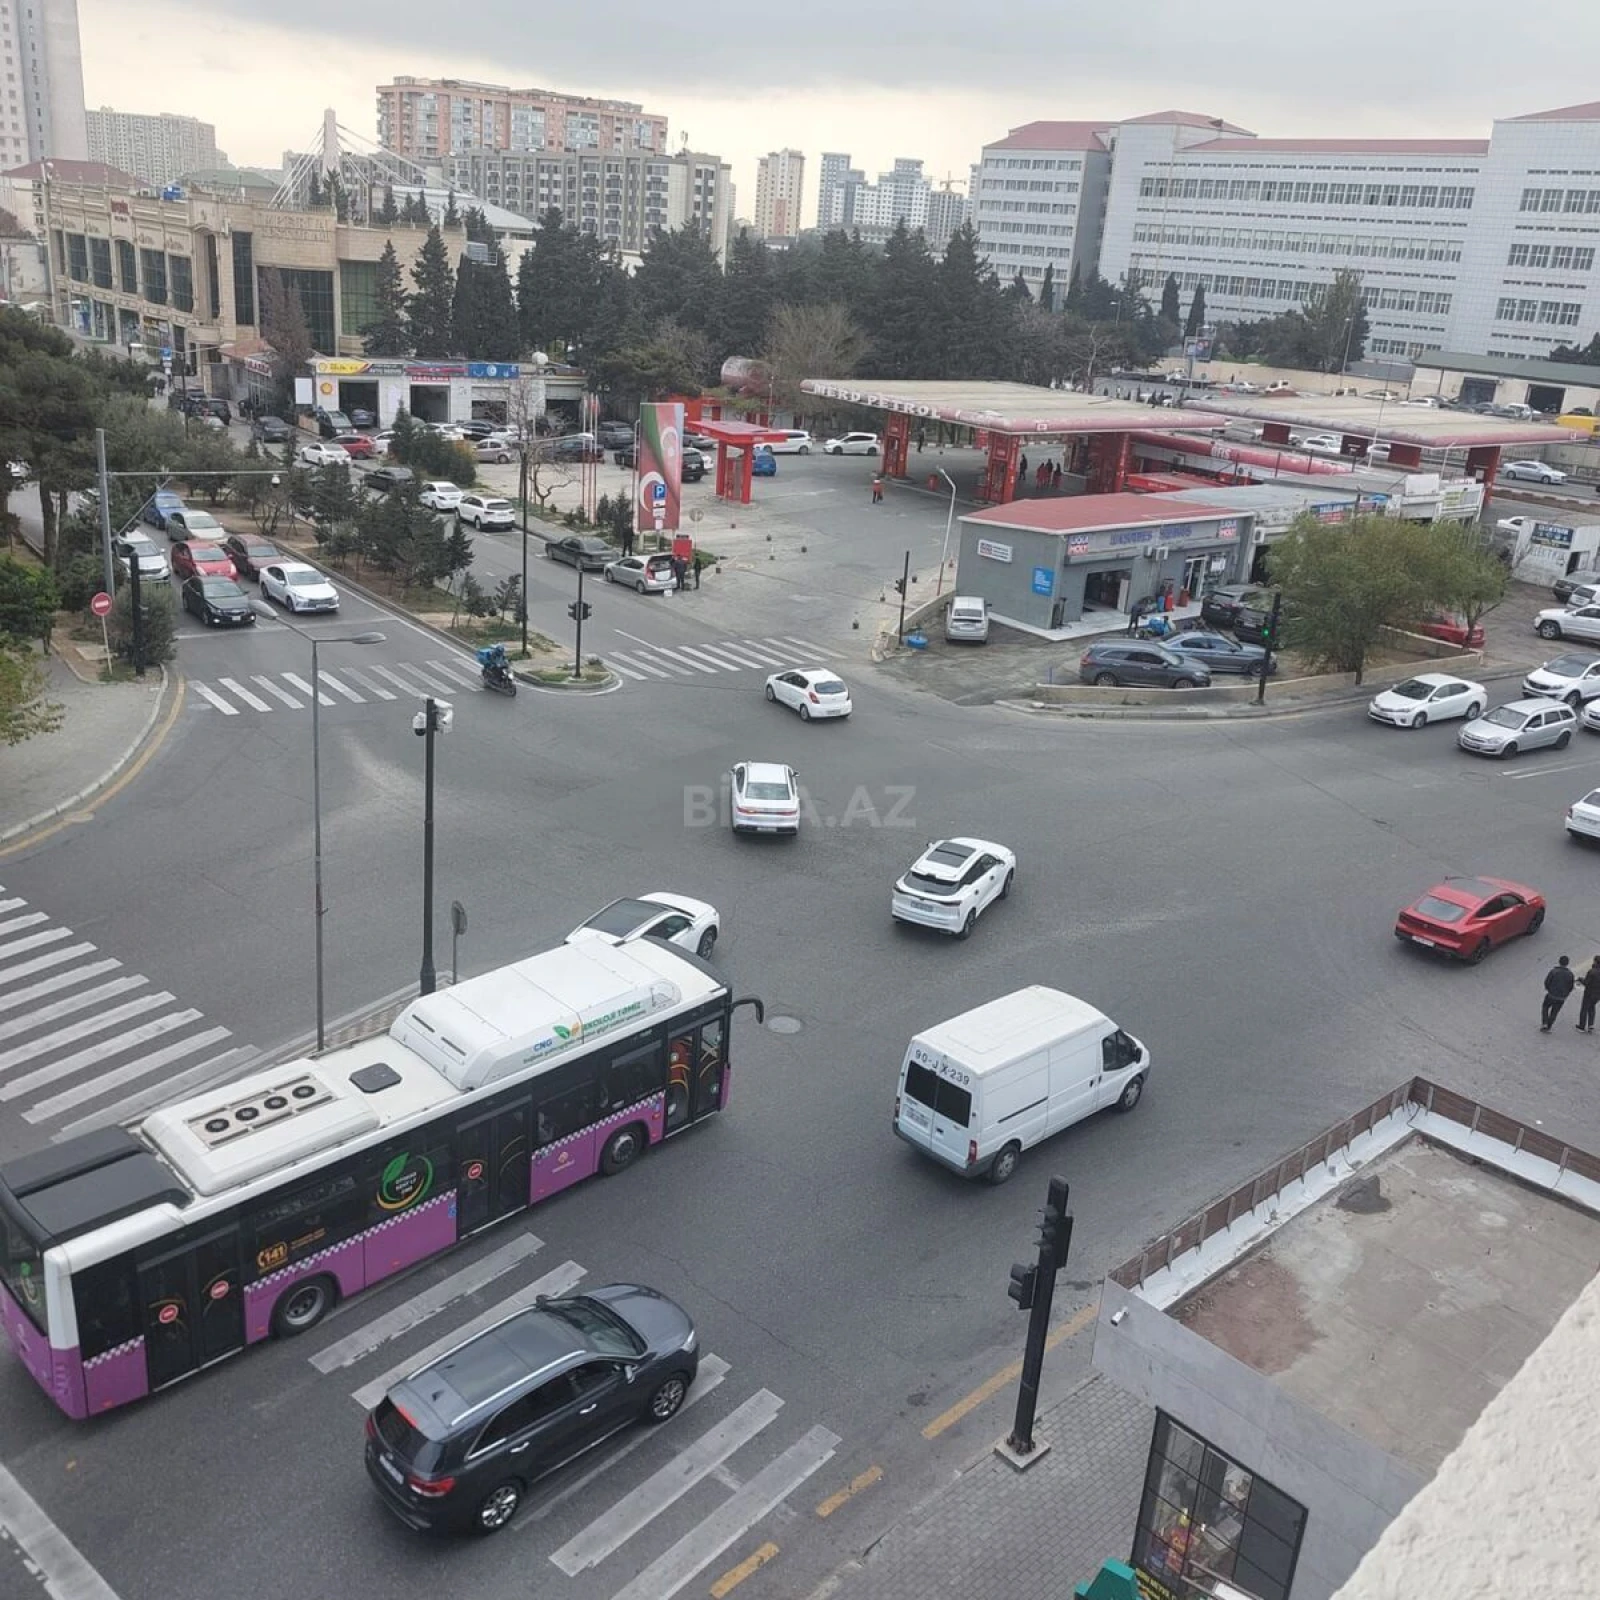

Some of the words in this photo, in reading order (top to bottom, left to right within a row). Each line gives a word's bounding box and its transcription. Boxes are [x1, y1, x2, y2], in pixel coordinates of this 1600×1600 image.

[867, 393, 941, 419] PETROL
[534, 1039, 553, 1052] CNG
[265, 1245, 286, 1264] 141
